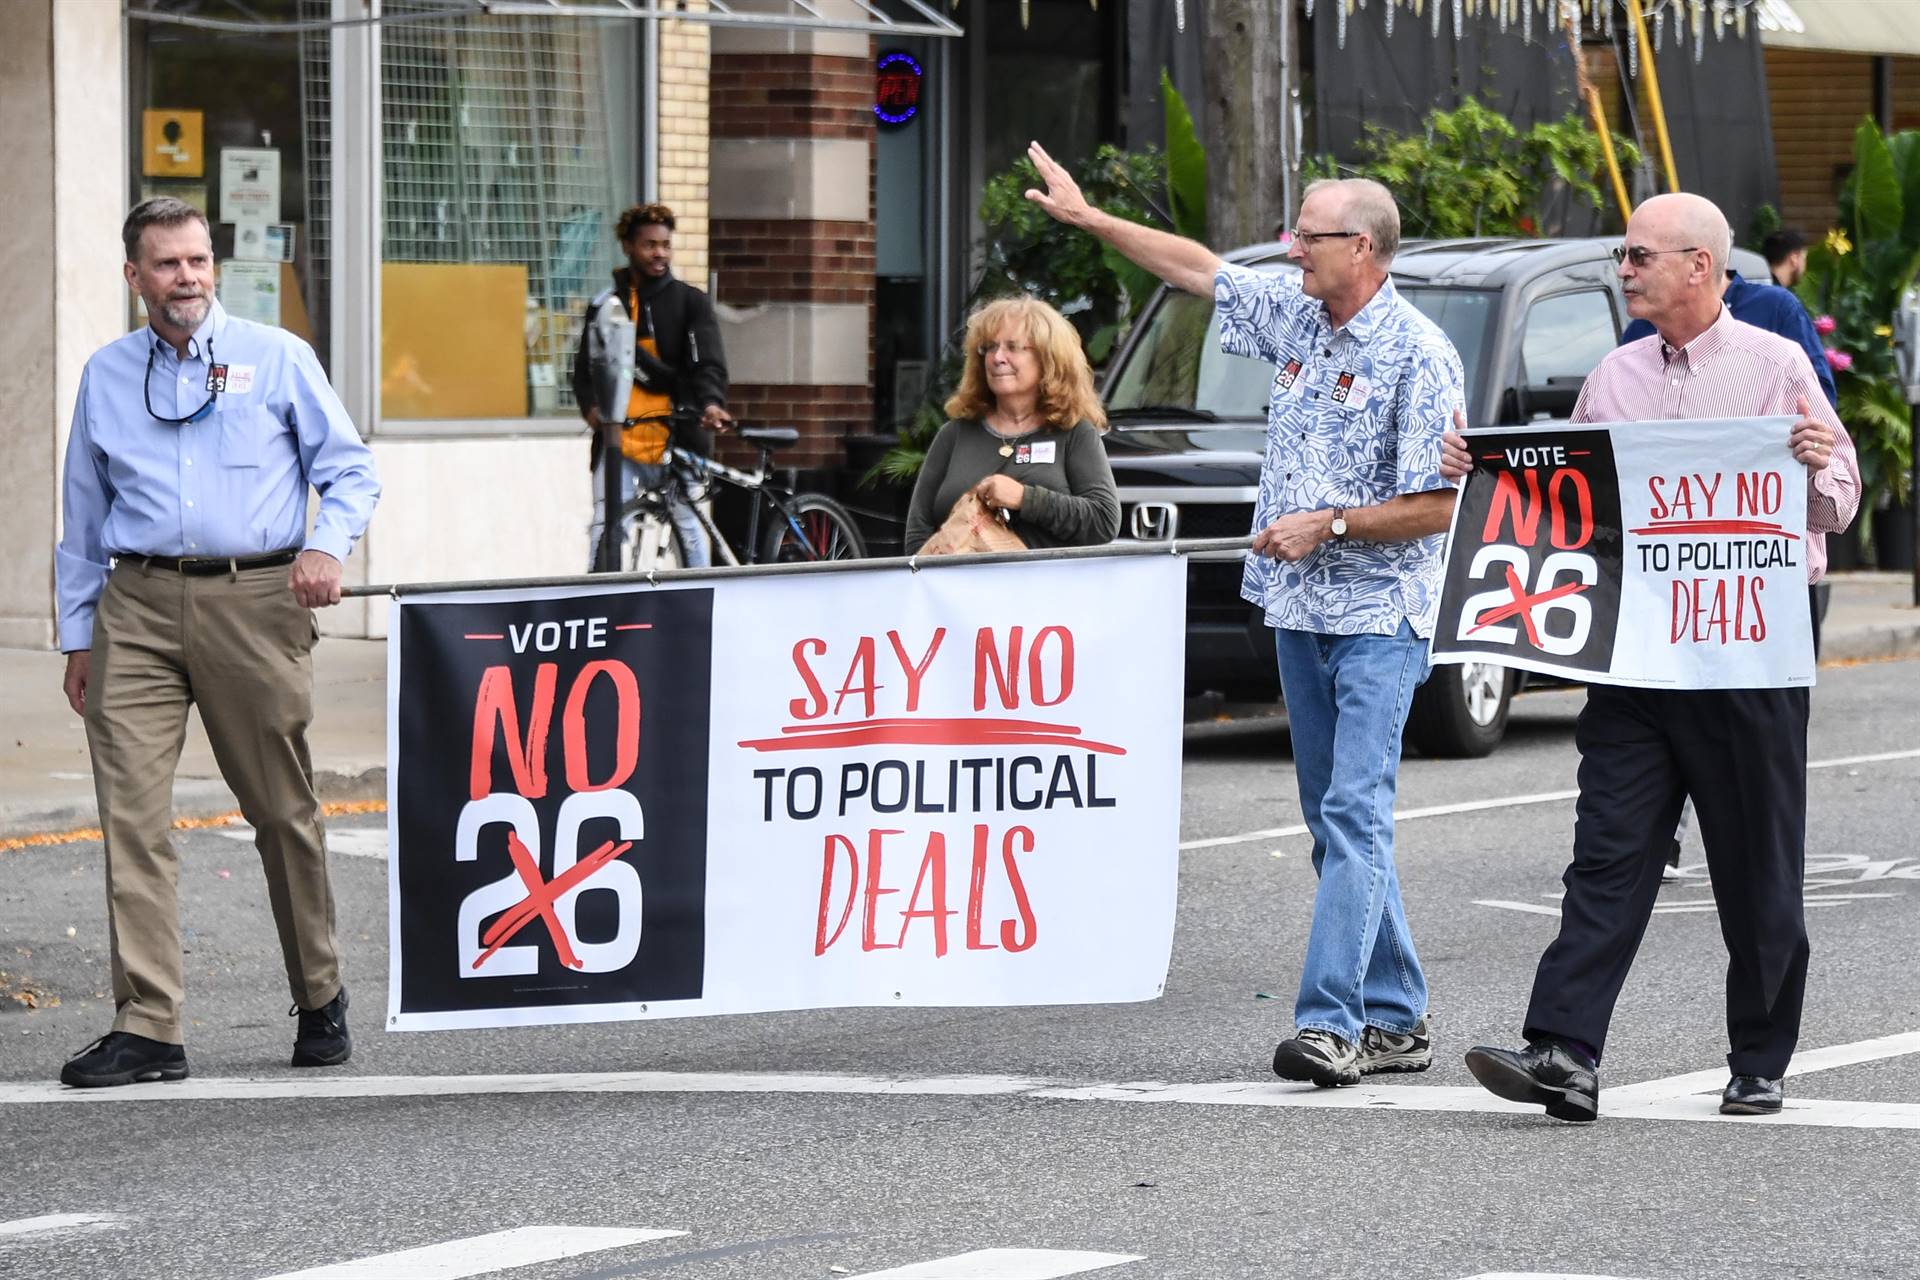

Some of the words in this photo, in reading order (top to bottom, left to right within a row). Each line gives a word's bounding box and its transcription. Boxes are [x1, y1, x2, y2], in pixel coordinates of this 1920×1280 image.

[877, 74, 920, 104] PEN
[1276, 370, 1295, 388] 26
[1332, 385, 1348, 401] 26
[1505, 447, 1567, 468] VOTE
[1482, 467, 1596, 551] NO
[1649, 472, 1722, 519] SAY
[1736, 472, 1783, 516] NO
[1637, 544, 1670, 572] TO
[1678, 539, 1797, 571] POLITICAL
[1456, 543, 1598, 656] 26
[1670, 575, 1766, 643] DEALS
[508, 617, 608, 654] VOTE
[789, 626, 947, 721] SAY
[973, 625, 1075, 711] NO
[469, 659, 641, 801] NO
[753, 767, 823, 822] TO
[838, 754, 1117, 817] POLITICAL
[455, 787, 645, 979] 26
[814, 824, 1038, 958] DEALS
